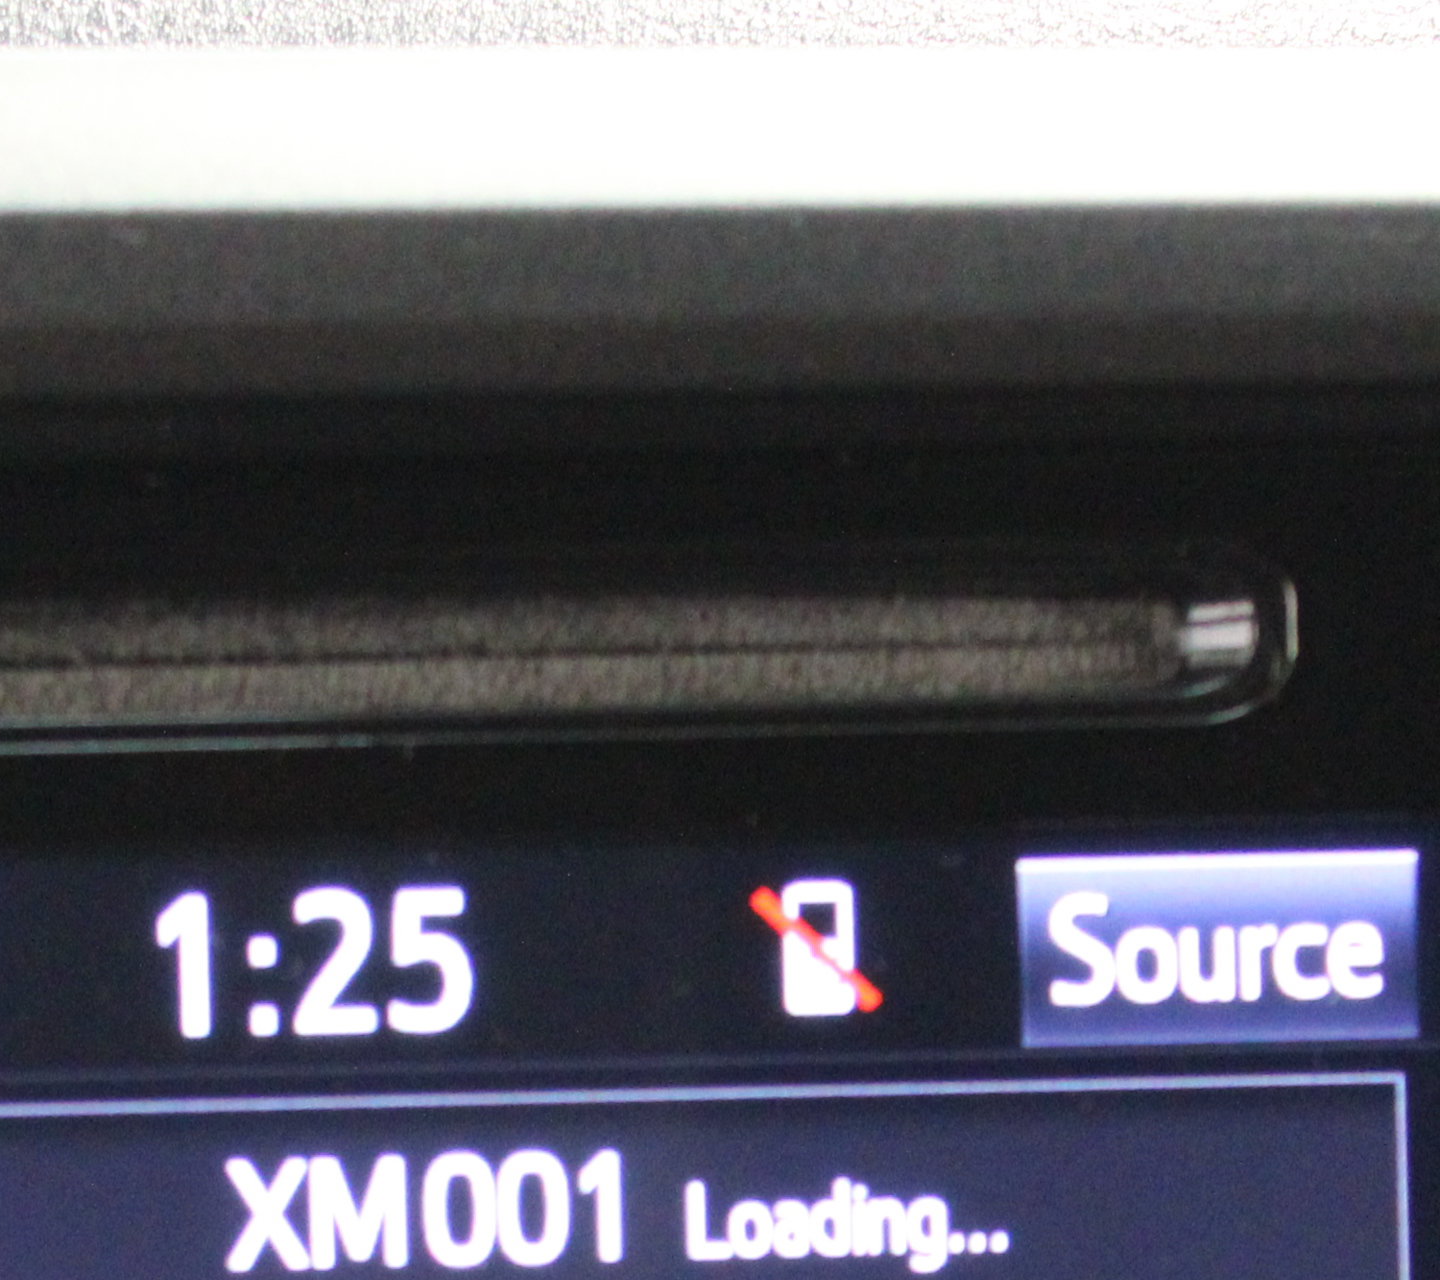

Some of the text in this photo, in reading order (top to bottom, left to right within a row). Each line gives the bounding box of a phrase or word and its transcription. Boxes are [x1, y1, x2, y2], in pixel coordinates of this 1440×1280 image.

[156, 886, 473, 1038] 1:25
[1046, 890, 1385, 1007] Source
[685, 1177, 1009, 1273] Loading...
